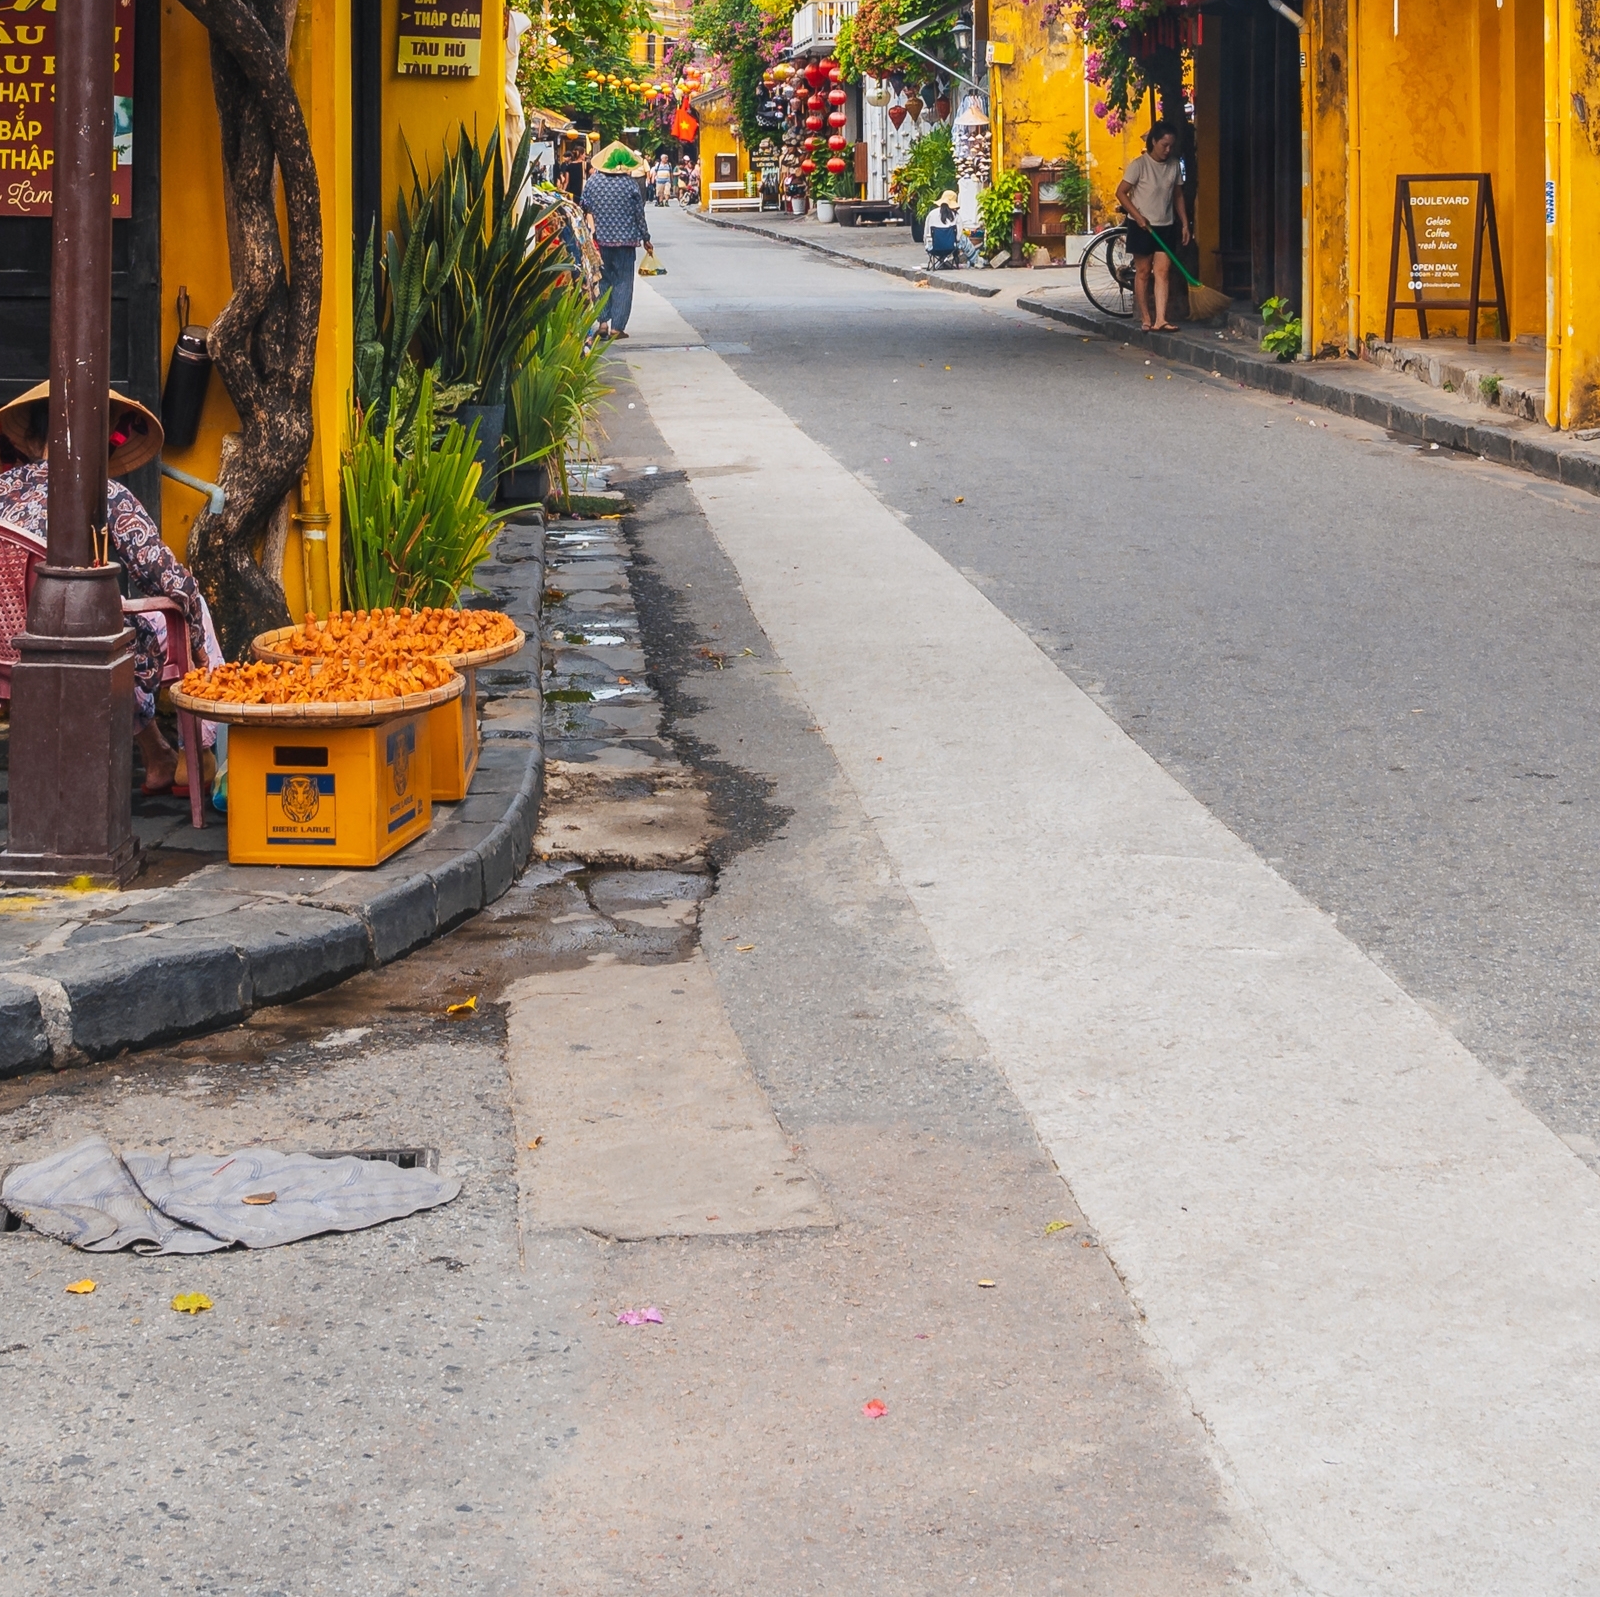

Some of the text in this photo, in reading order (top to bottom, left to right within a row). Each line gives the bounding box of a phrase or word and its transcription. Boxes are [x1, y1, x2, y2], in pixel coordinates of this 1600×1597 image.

[414, 8, 480, 29] THẬP CẨM
[411, 40, 466, 57] TÀU HỦ
[7, 179, 54, 212] Làm
[1410, 196, 1469, 206] BOULEVARD
[1425, 216, 1452, 226] Gelato
[1425, 227, 1451, 238] Coffee
[1438, 240, 1458, 250] Juice
[1412, 263, 1458, 271] OPEN DAILY
[272, 825, 331, 834] BIERE LARUE
